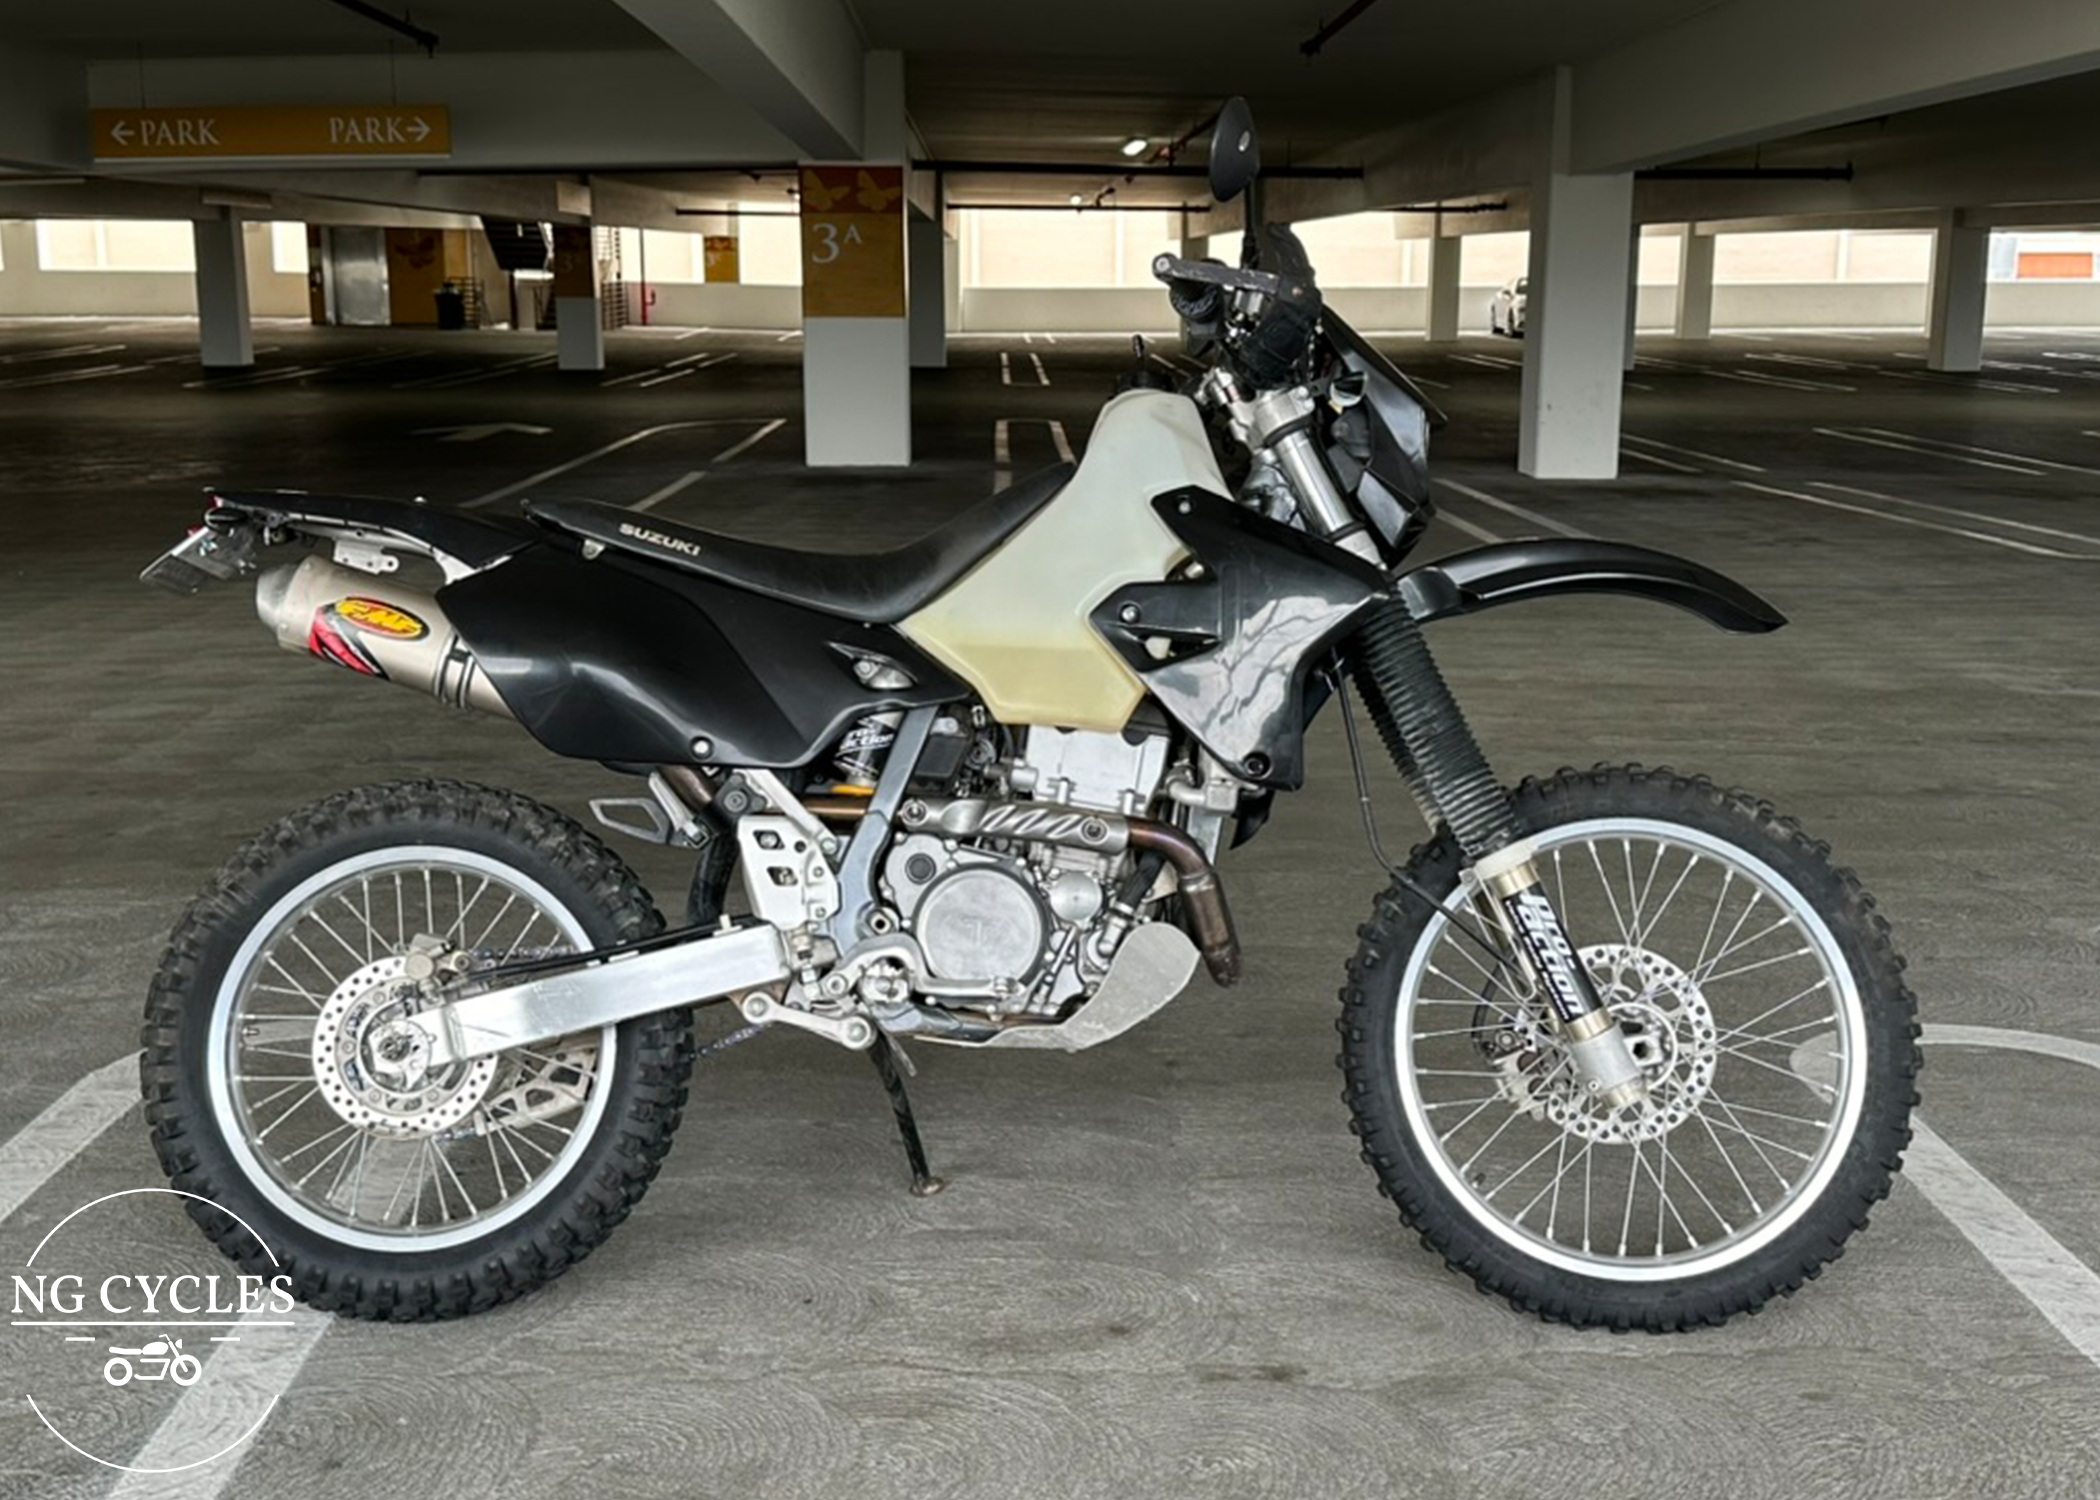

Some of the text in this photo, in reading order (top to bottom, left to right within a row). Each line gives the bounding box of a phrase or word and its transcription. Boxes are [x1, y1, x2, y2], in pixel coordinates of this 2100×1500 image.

[141, 119, 220, 146] PARK
[329, 117, 407, 144] PARK
[619, 523, 701, 556] SUZUKI
[1517, 905, 1584, 1013] action
